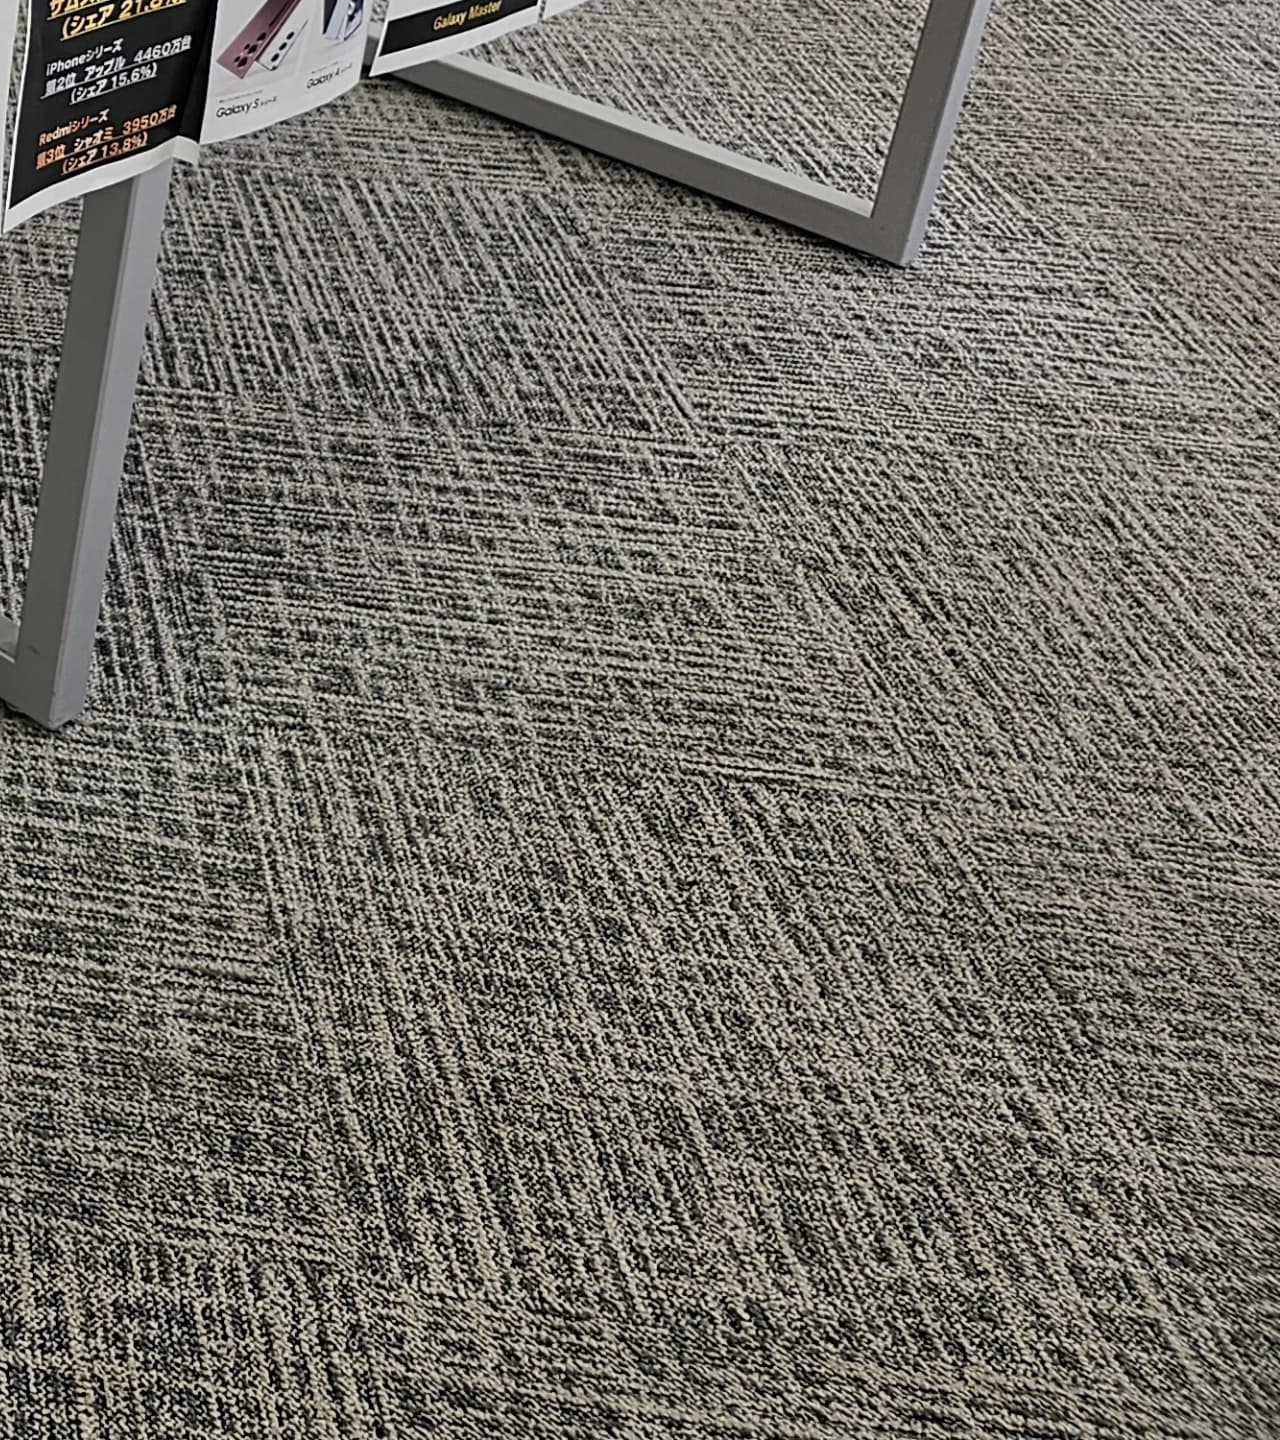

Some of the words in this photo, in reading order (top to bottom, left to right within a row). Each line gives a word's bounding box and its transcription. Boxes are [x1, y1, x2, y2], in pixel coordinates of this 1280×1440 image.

[432, 8, 469, 32] Galaxy
[46, 38, 124, 77] iPhoneシリーズ
